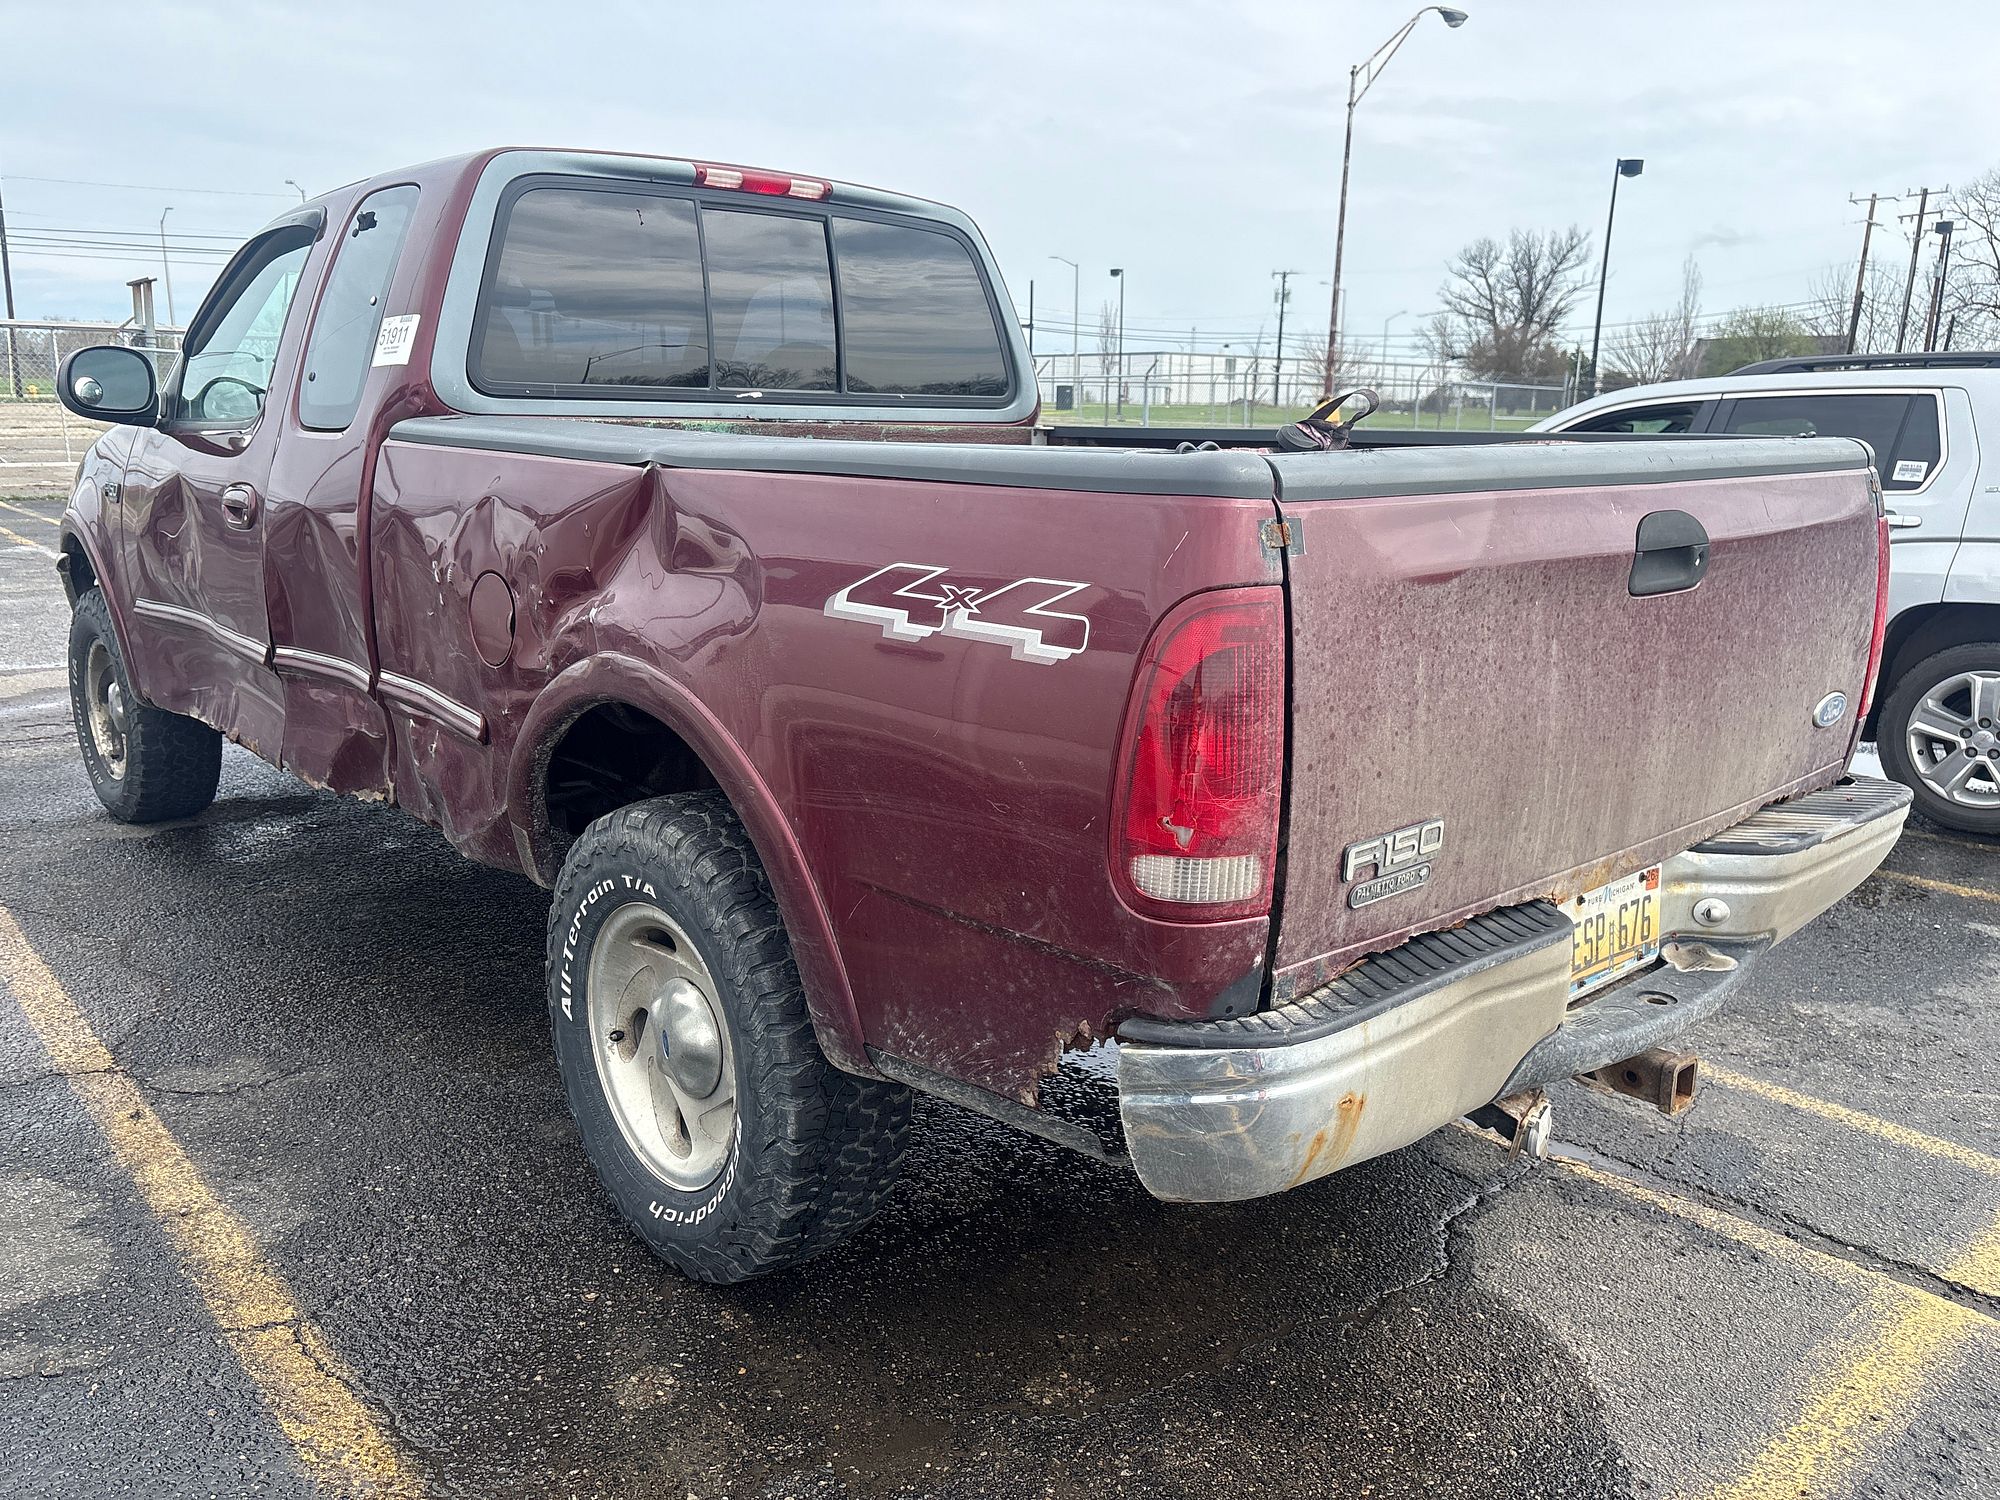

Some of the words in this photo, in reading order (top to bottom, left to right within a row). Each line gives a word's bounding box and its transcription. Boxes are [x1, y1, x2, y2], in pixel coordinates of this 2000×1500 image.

[379, 326, 409, 346] 51911
[1356, 879, 1395, 900] PALMETTO
[1396, 871, 1415, 886] FORD
[1587, 894, 1603, 906] PURE
[1602, 882, 1635, 904] MICHIGAN
[1571, 912, 1605, 973] ESP
[1618, 894, 1652, 950] 676
[561, 878, 615, 1022] All-Terrain
